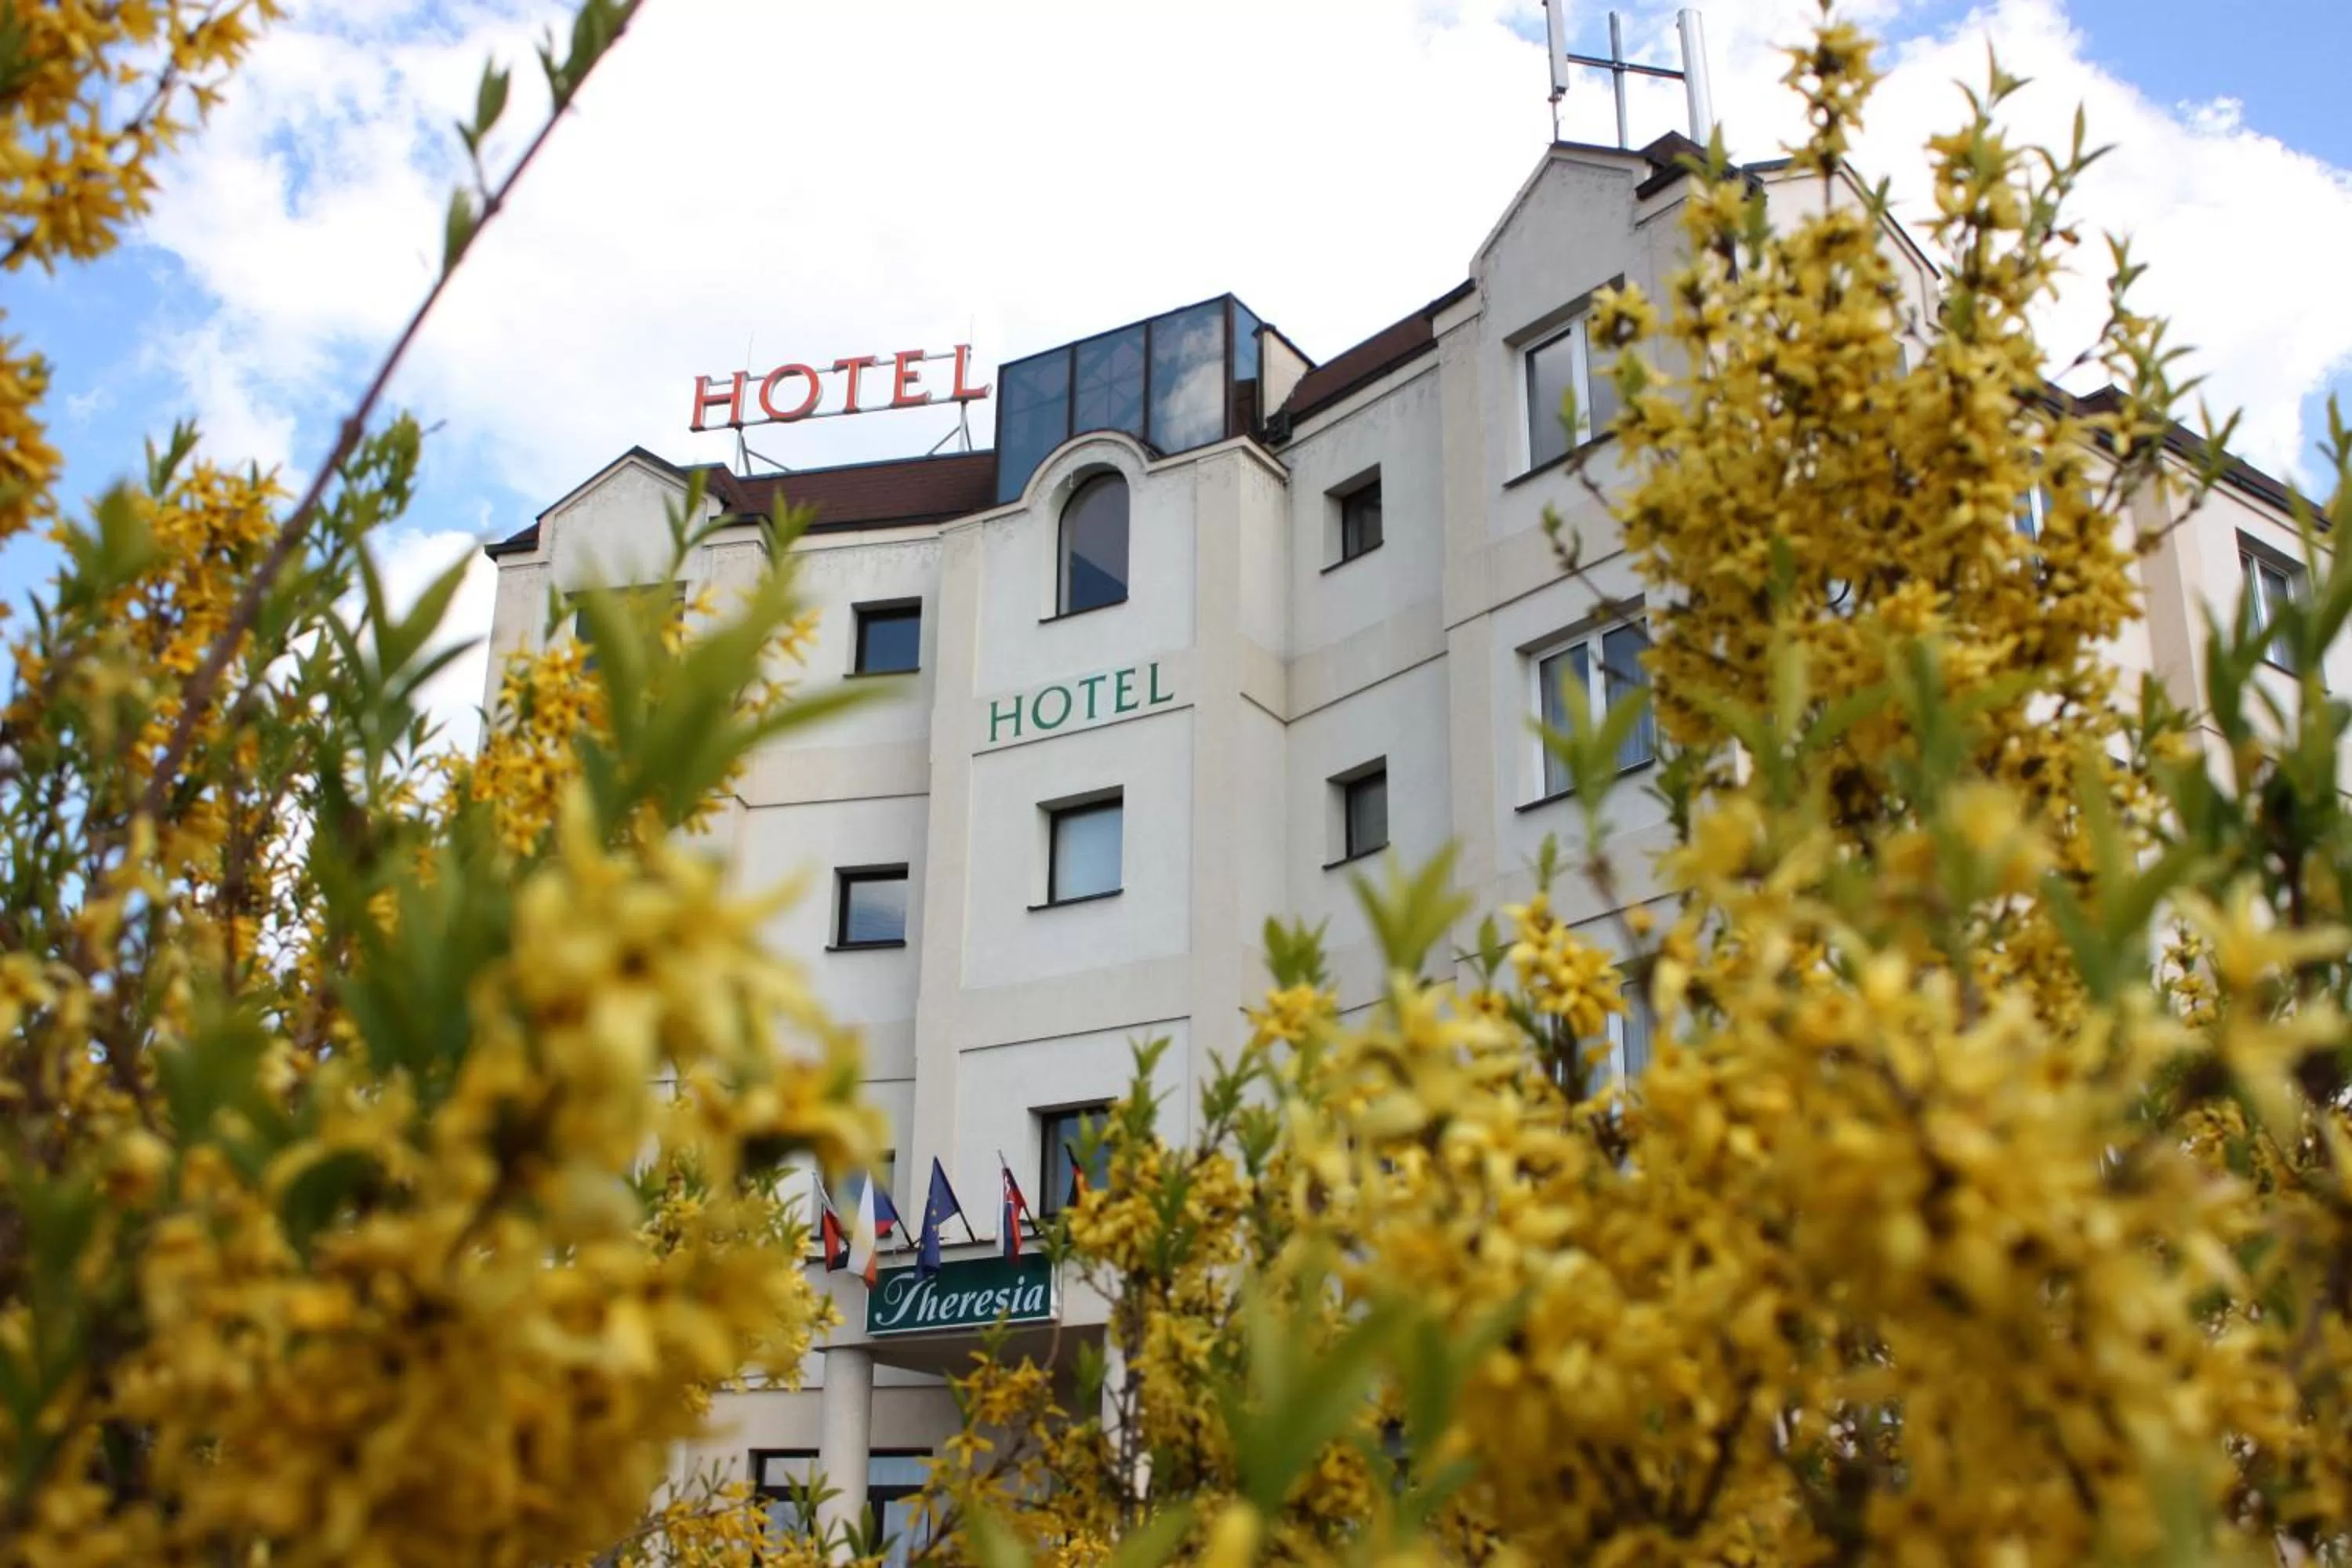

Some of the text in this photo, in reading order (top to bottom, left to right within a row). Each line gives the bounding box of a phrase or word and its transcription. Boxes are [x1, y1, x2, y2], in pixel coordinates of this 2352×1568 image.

[689, 344, 993, 432] HOTEL
[989, 662, 1174, 742] HOTEL
[874, 1272, 1045, 1326] Theresia
